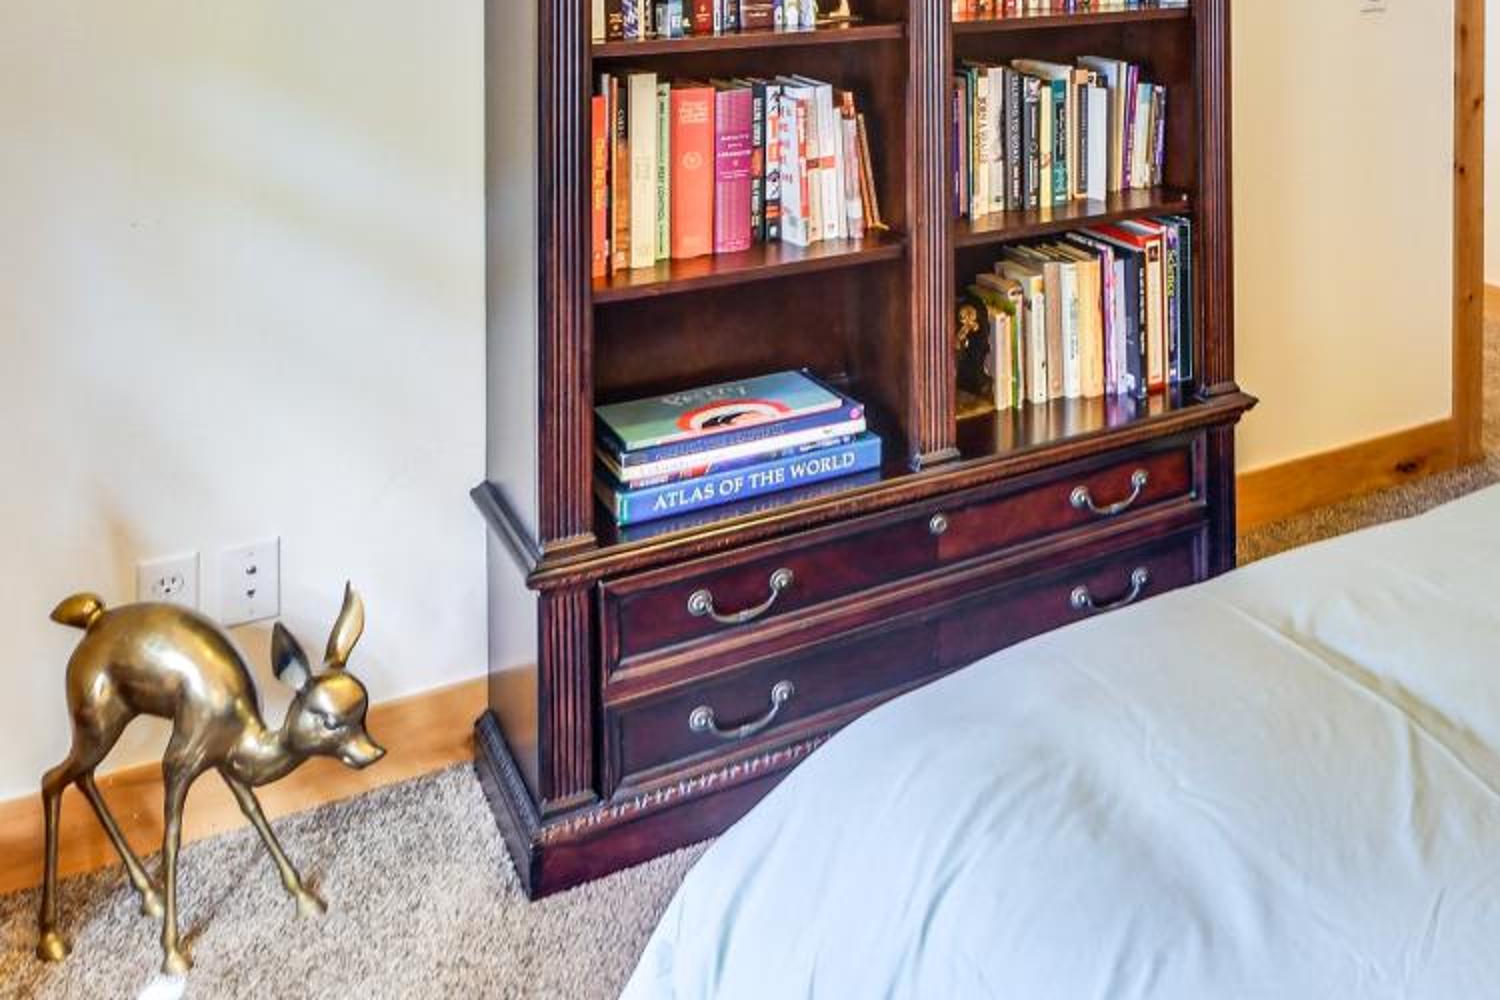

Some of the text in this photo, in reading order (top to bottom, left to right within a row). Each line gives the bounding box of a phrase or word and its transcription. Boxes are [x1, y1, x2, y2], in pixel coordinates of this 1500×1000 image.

[653, 452, 856, 511] ATLAS OF THE WORLD
